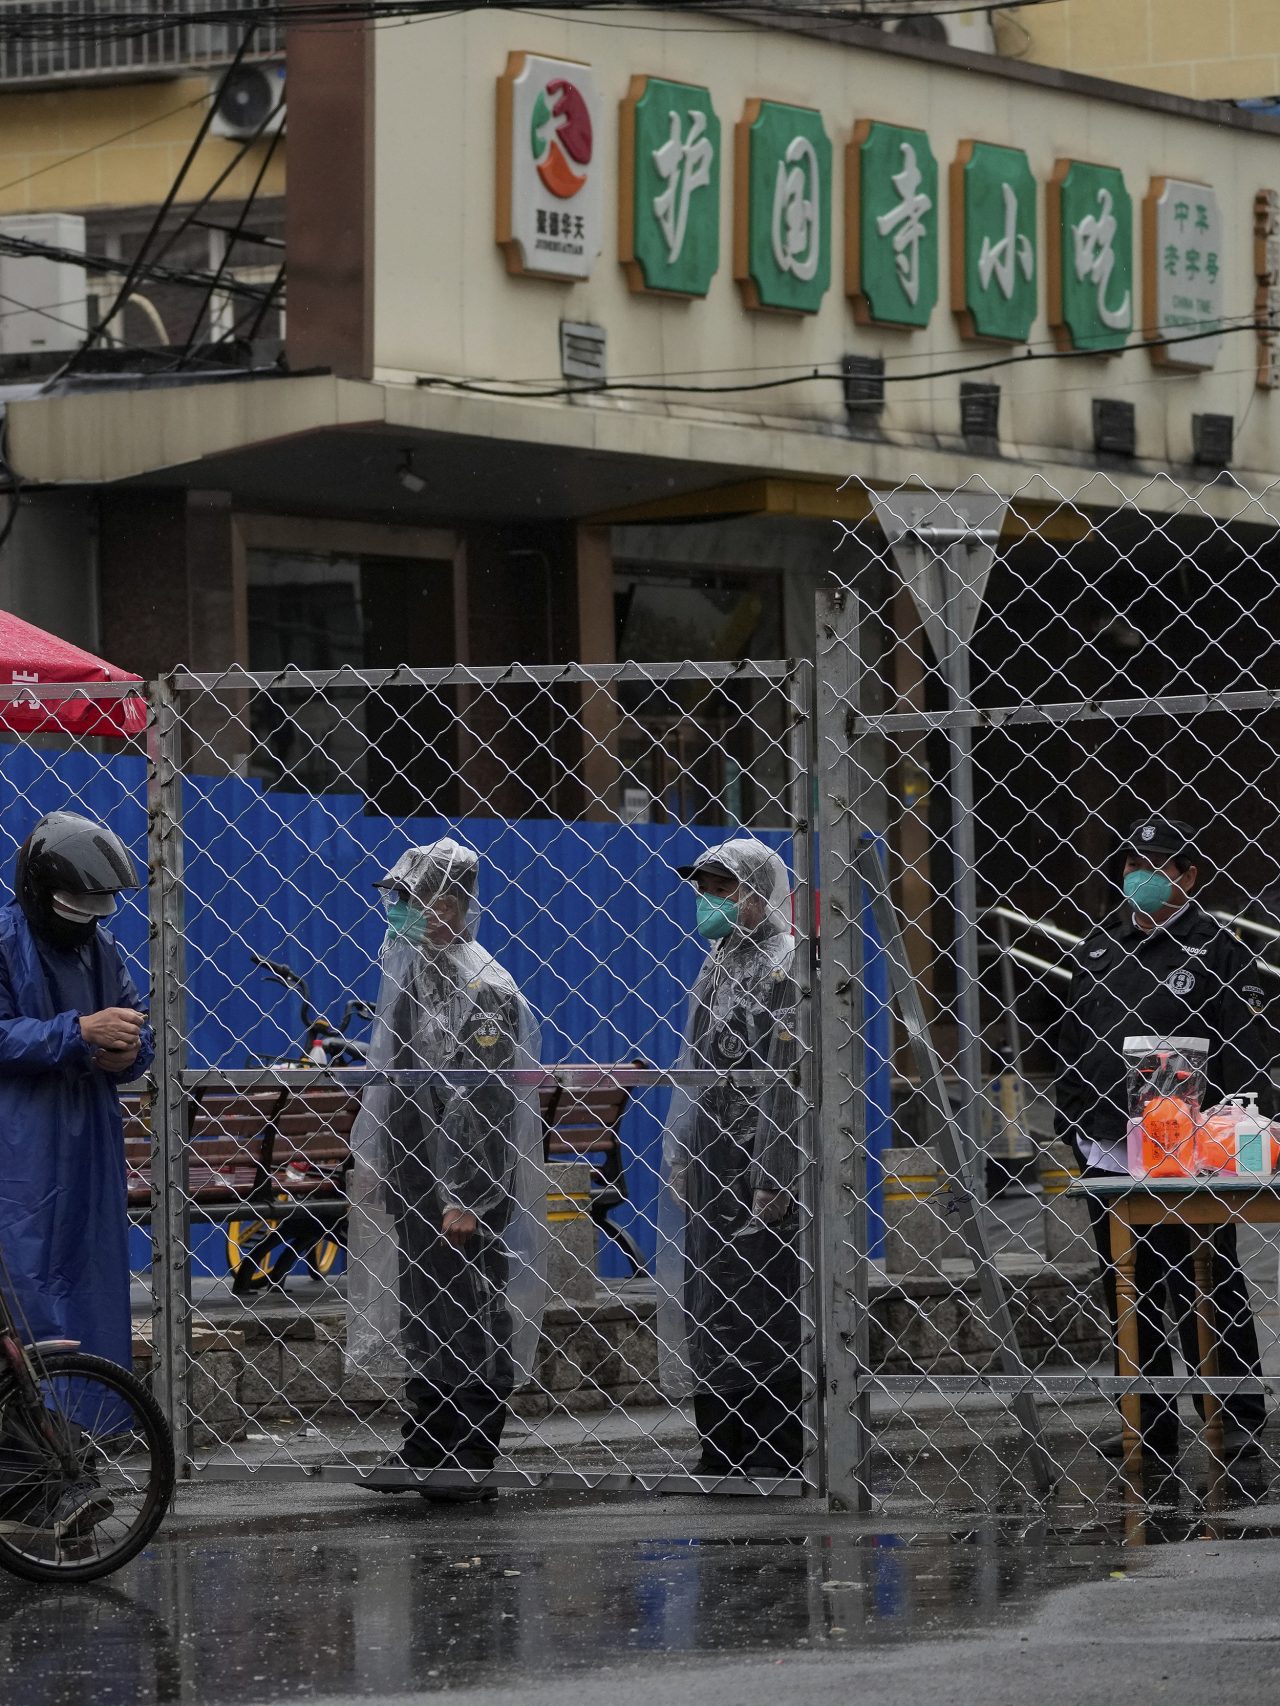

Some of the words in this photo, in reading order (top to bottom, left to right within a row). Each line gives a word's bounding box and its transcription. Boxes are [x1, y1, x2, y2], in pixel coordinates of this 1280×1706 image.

[652, 109, 1131, 329] 护国寺小吃
[1163, 243, 1220, 285] 老字号
